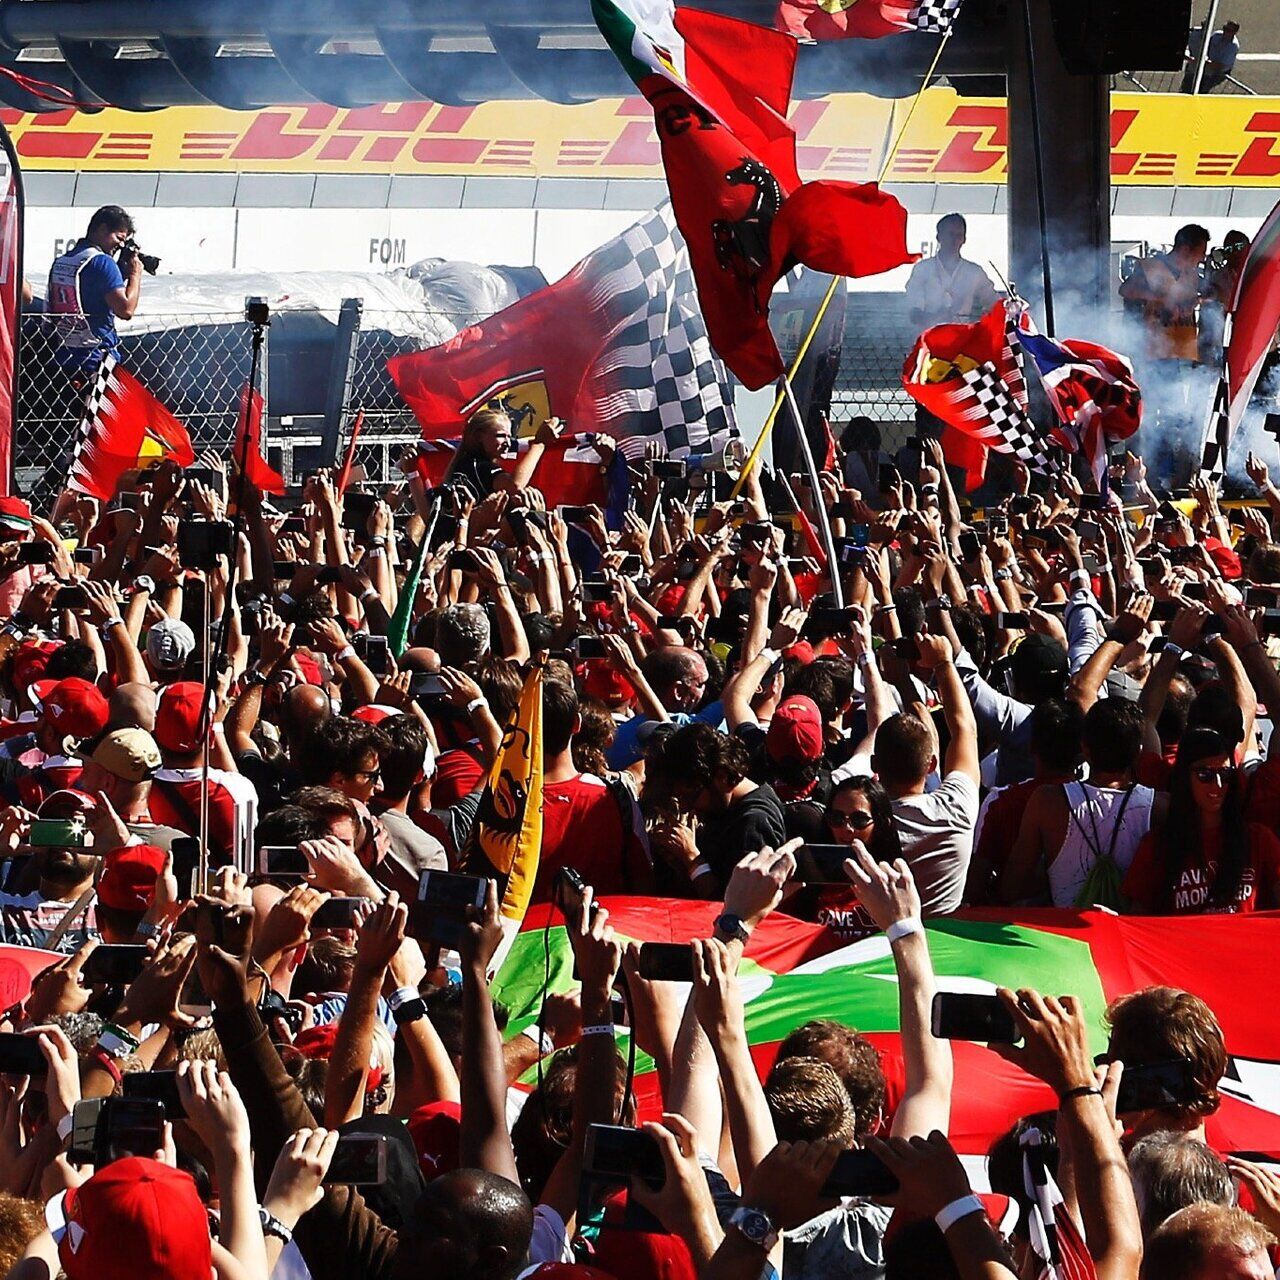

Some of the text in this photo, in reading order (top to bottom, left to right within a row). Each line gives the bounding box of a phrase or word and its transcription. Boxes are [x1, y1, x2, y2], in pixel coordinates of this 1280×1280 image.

[230, 101, 488, 163] DHL
[369, 237, 407, 265] FOM
[817, 908, 854, 927] SAVE
